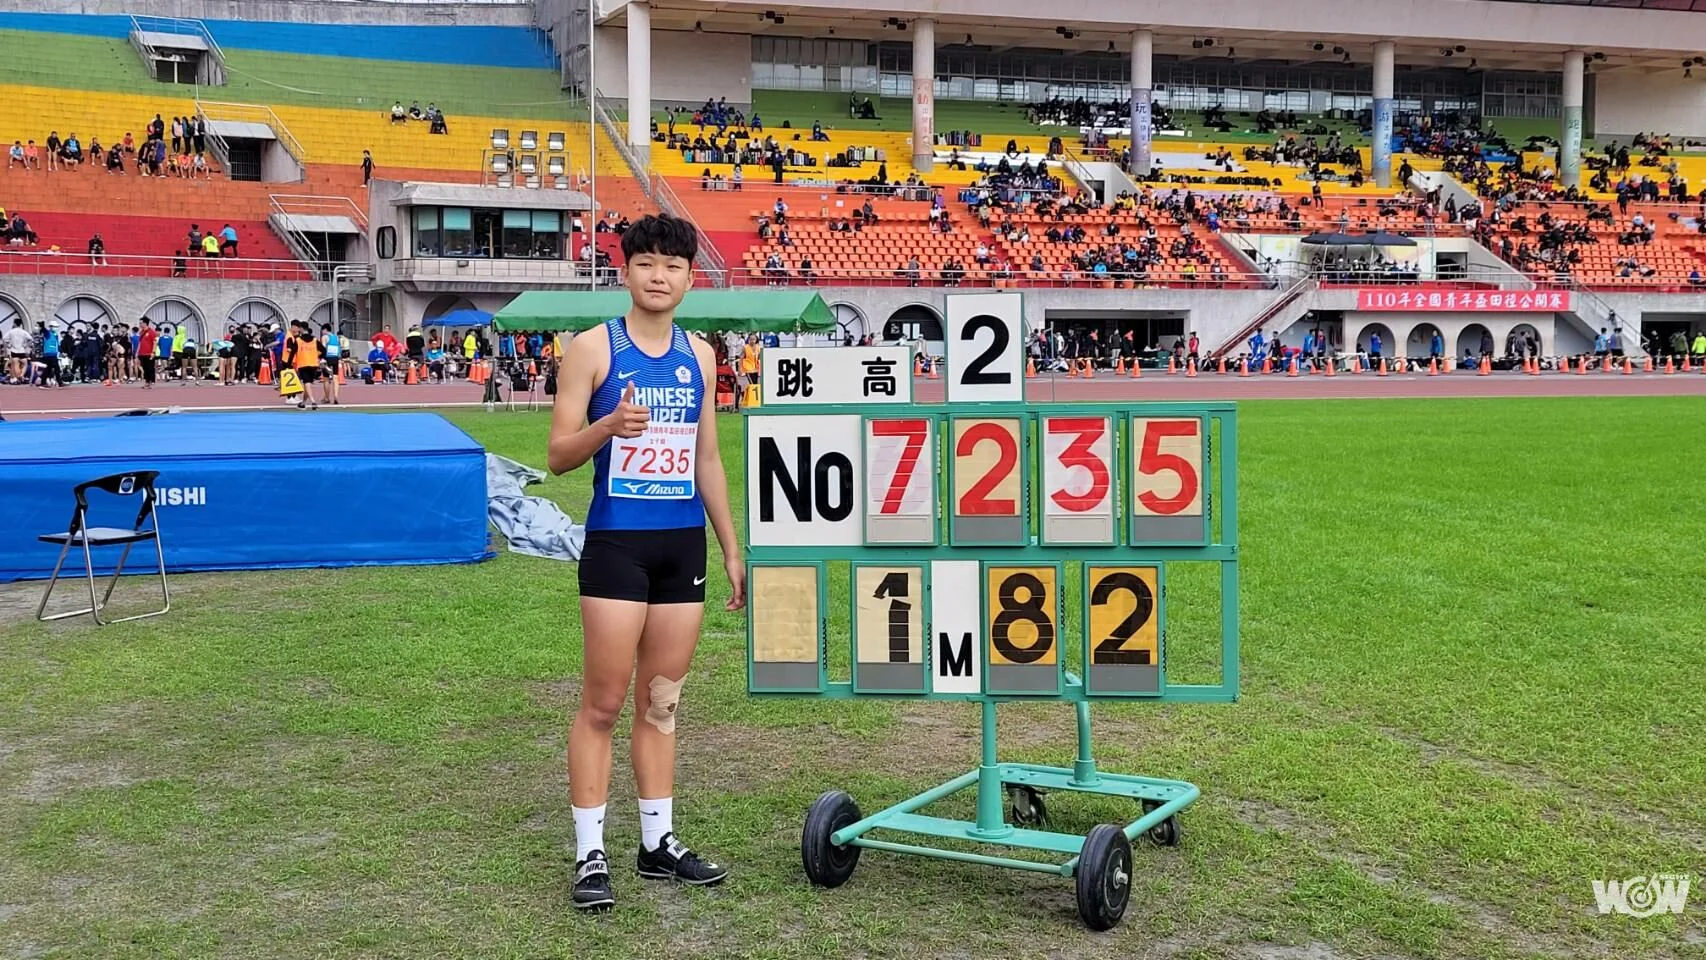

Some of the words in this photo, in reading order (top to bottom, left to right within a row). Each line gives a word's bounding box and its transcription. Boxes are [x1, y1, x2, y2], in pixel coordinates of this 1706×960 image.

[961, 315, 1010, 384] 2
[283, 371, 296, 387] 2
[620, 446, 690, 474] 7235
[760, 437, 853, 522] No
[940, 633, 973, 677] M
[586, 862, 605, 873] NIKE
